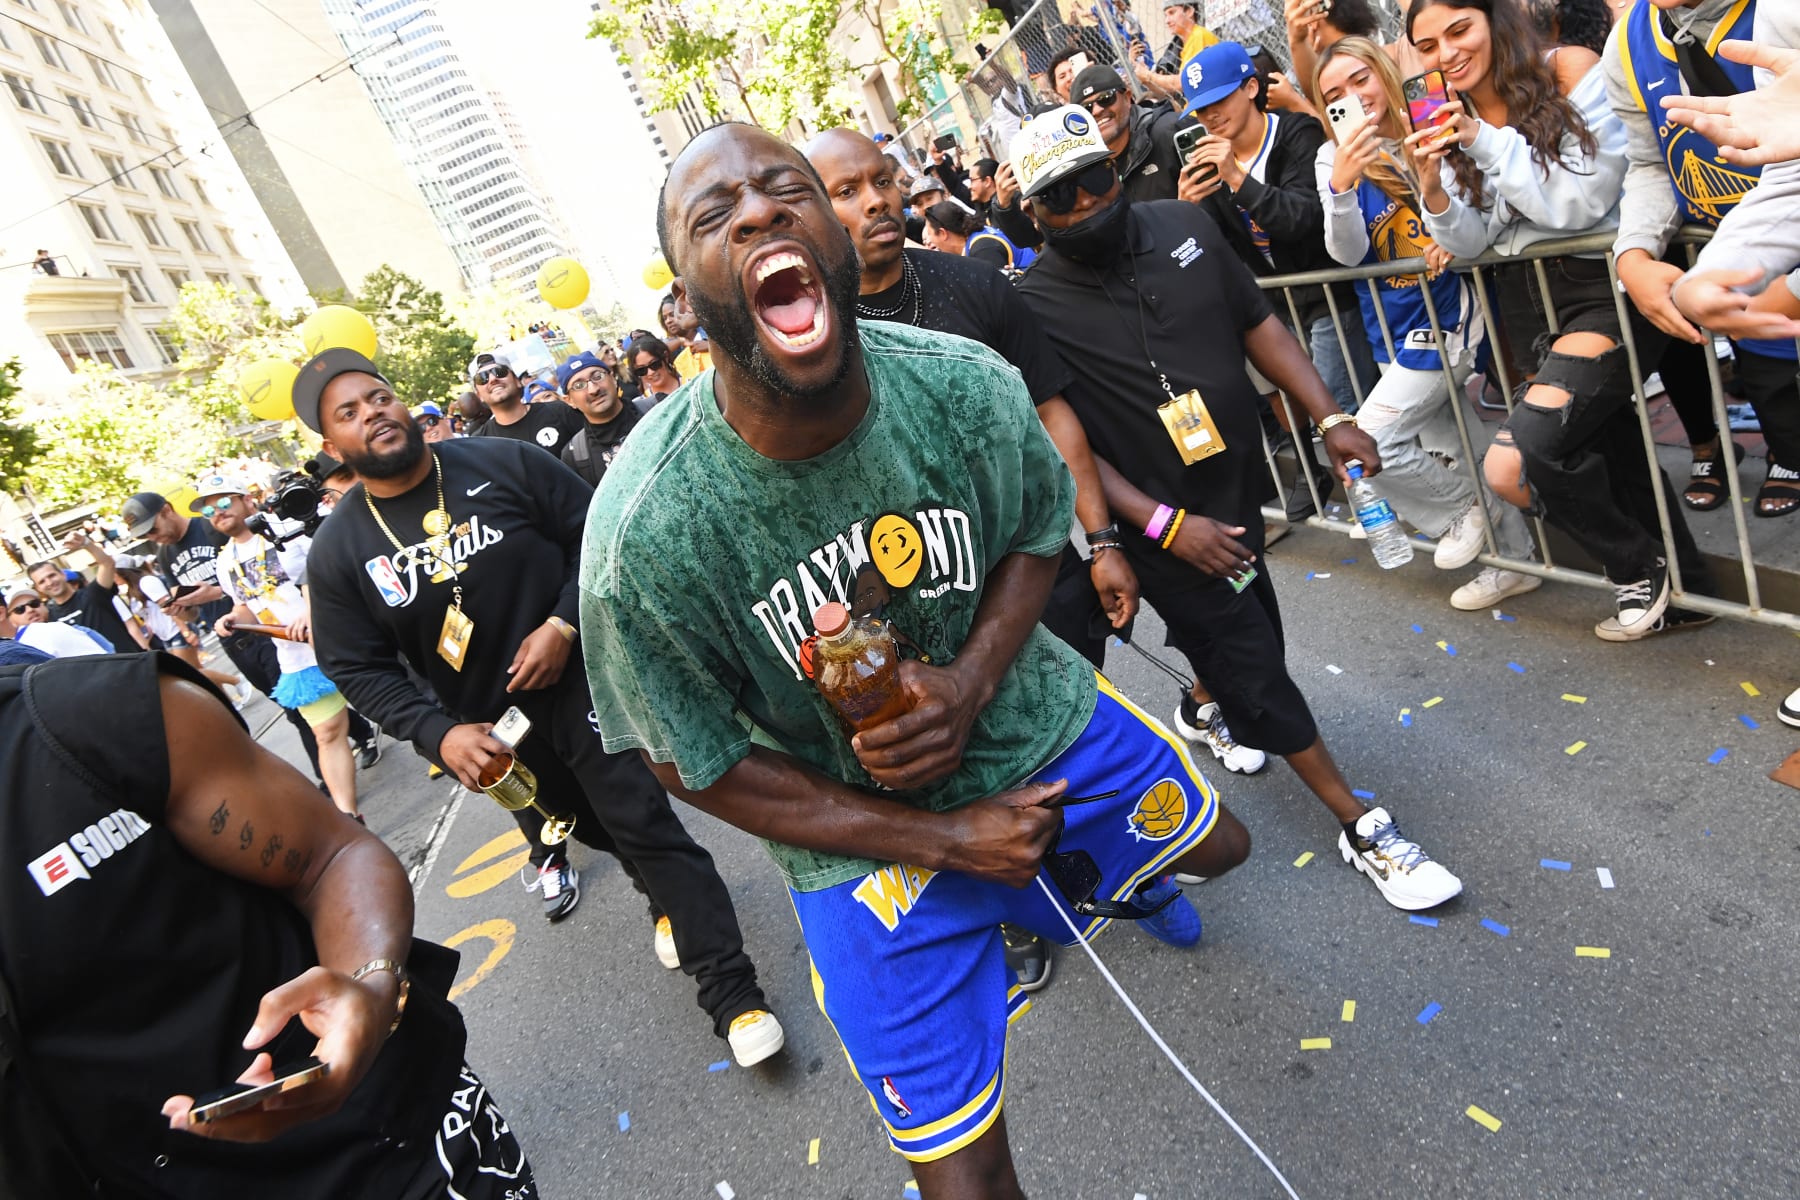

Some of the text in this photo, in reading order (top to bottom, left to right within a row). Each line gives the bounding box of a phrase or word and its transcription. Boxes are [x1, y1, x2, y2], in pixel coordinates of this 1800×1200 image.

[1021, 135, 1097, 184] Champions
[1691, 462, 1713, 476] IKE
[391, 515, 504, 608] Finals
[919, 581, 951, 599] GREEN
[69, 807, 152, 869] SOCIAL
